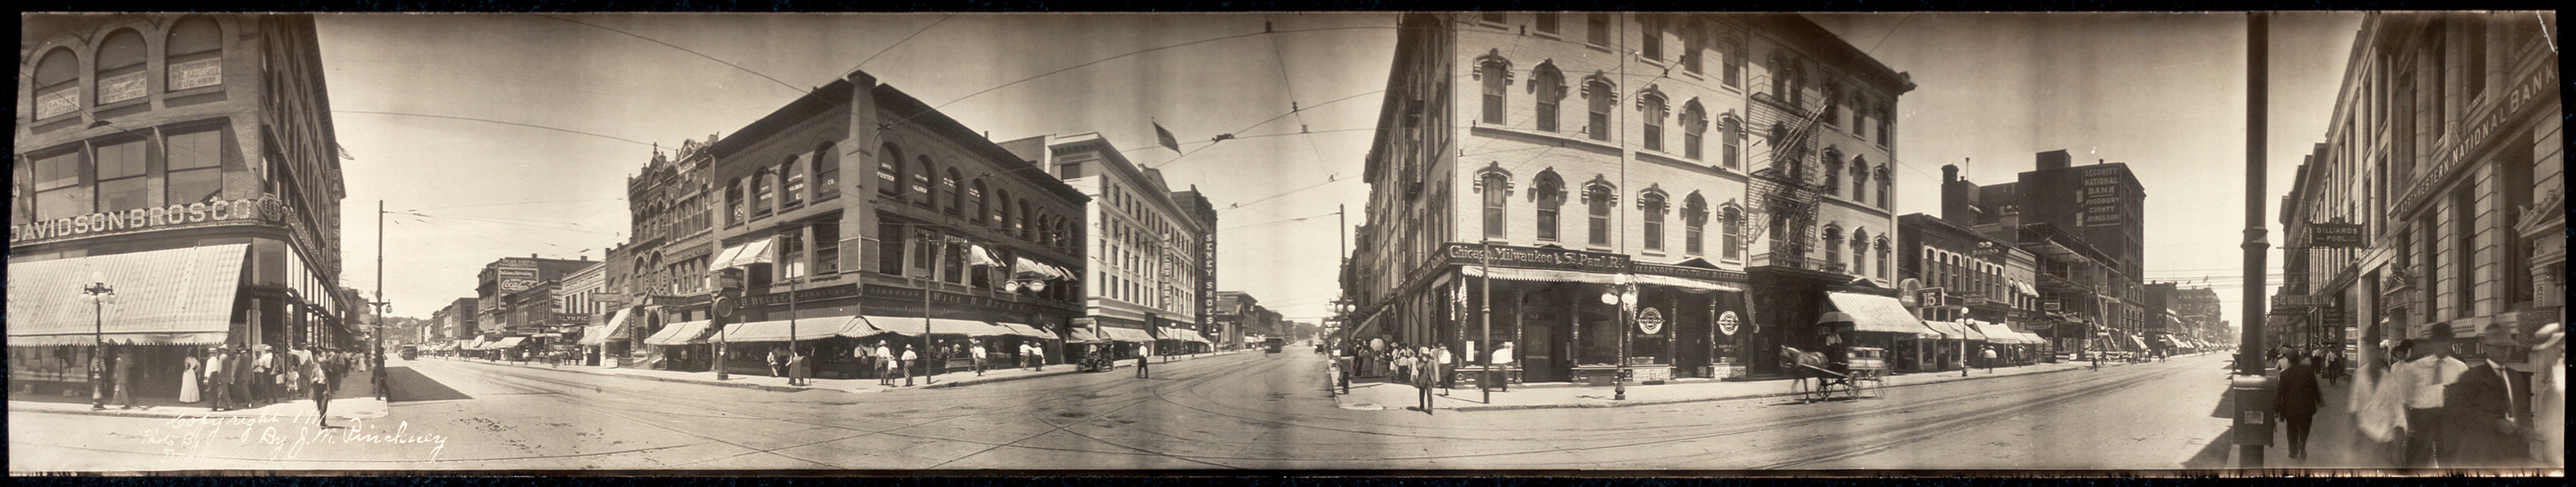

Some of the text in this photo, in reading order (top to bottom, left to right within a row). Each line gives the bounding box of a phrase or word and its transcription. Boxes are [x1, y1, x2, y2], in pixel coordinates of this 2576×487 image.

[2453, 107, 2506, 167] NATIONAL
[2510, 60, 2556, 114] BANK
[877, 171, 895, 182] FOSTER
[2085, 167, 2119, 177] SECURITY
[2084, 177, 2119, 187] NATIONAL
[2088, 186, 2115, 195] BANK
[10, 211, 125, 242] DAVIDSON
[130, 202, 206, 229] BROS
[212, 198, 251, 221] CO
[1495, 248, 1553, 263] Milwaukee
[1579, 254, 1605, 267] Paul
[1634, 265, 1674, 274] ILLINOIS
[1711, 271, 1749, 281] RAILROAD
[752, 294, 778, 306] BECK
[870, 287, 919, 297] DIAMONDS
[933, 291, 962, 303] WILL
[986, 298, 1013, 311] BECK
[1206, 282, 1214, 324] SHOES
[1922, 291, 1937, 307] 15
